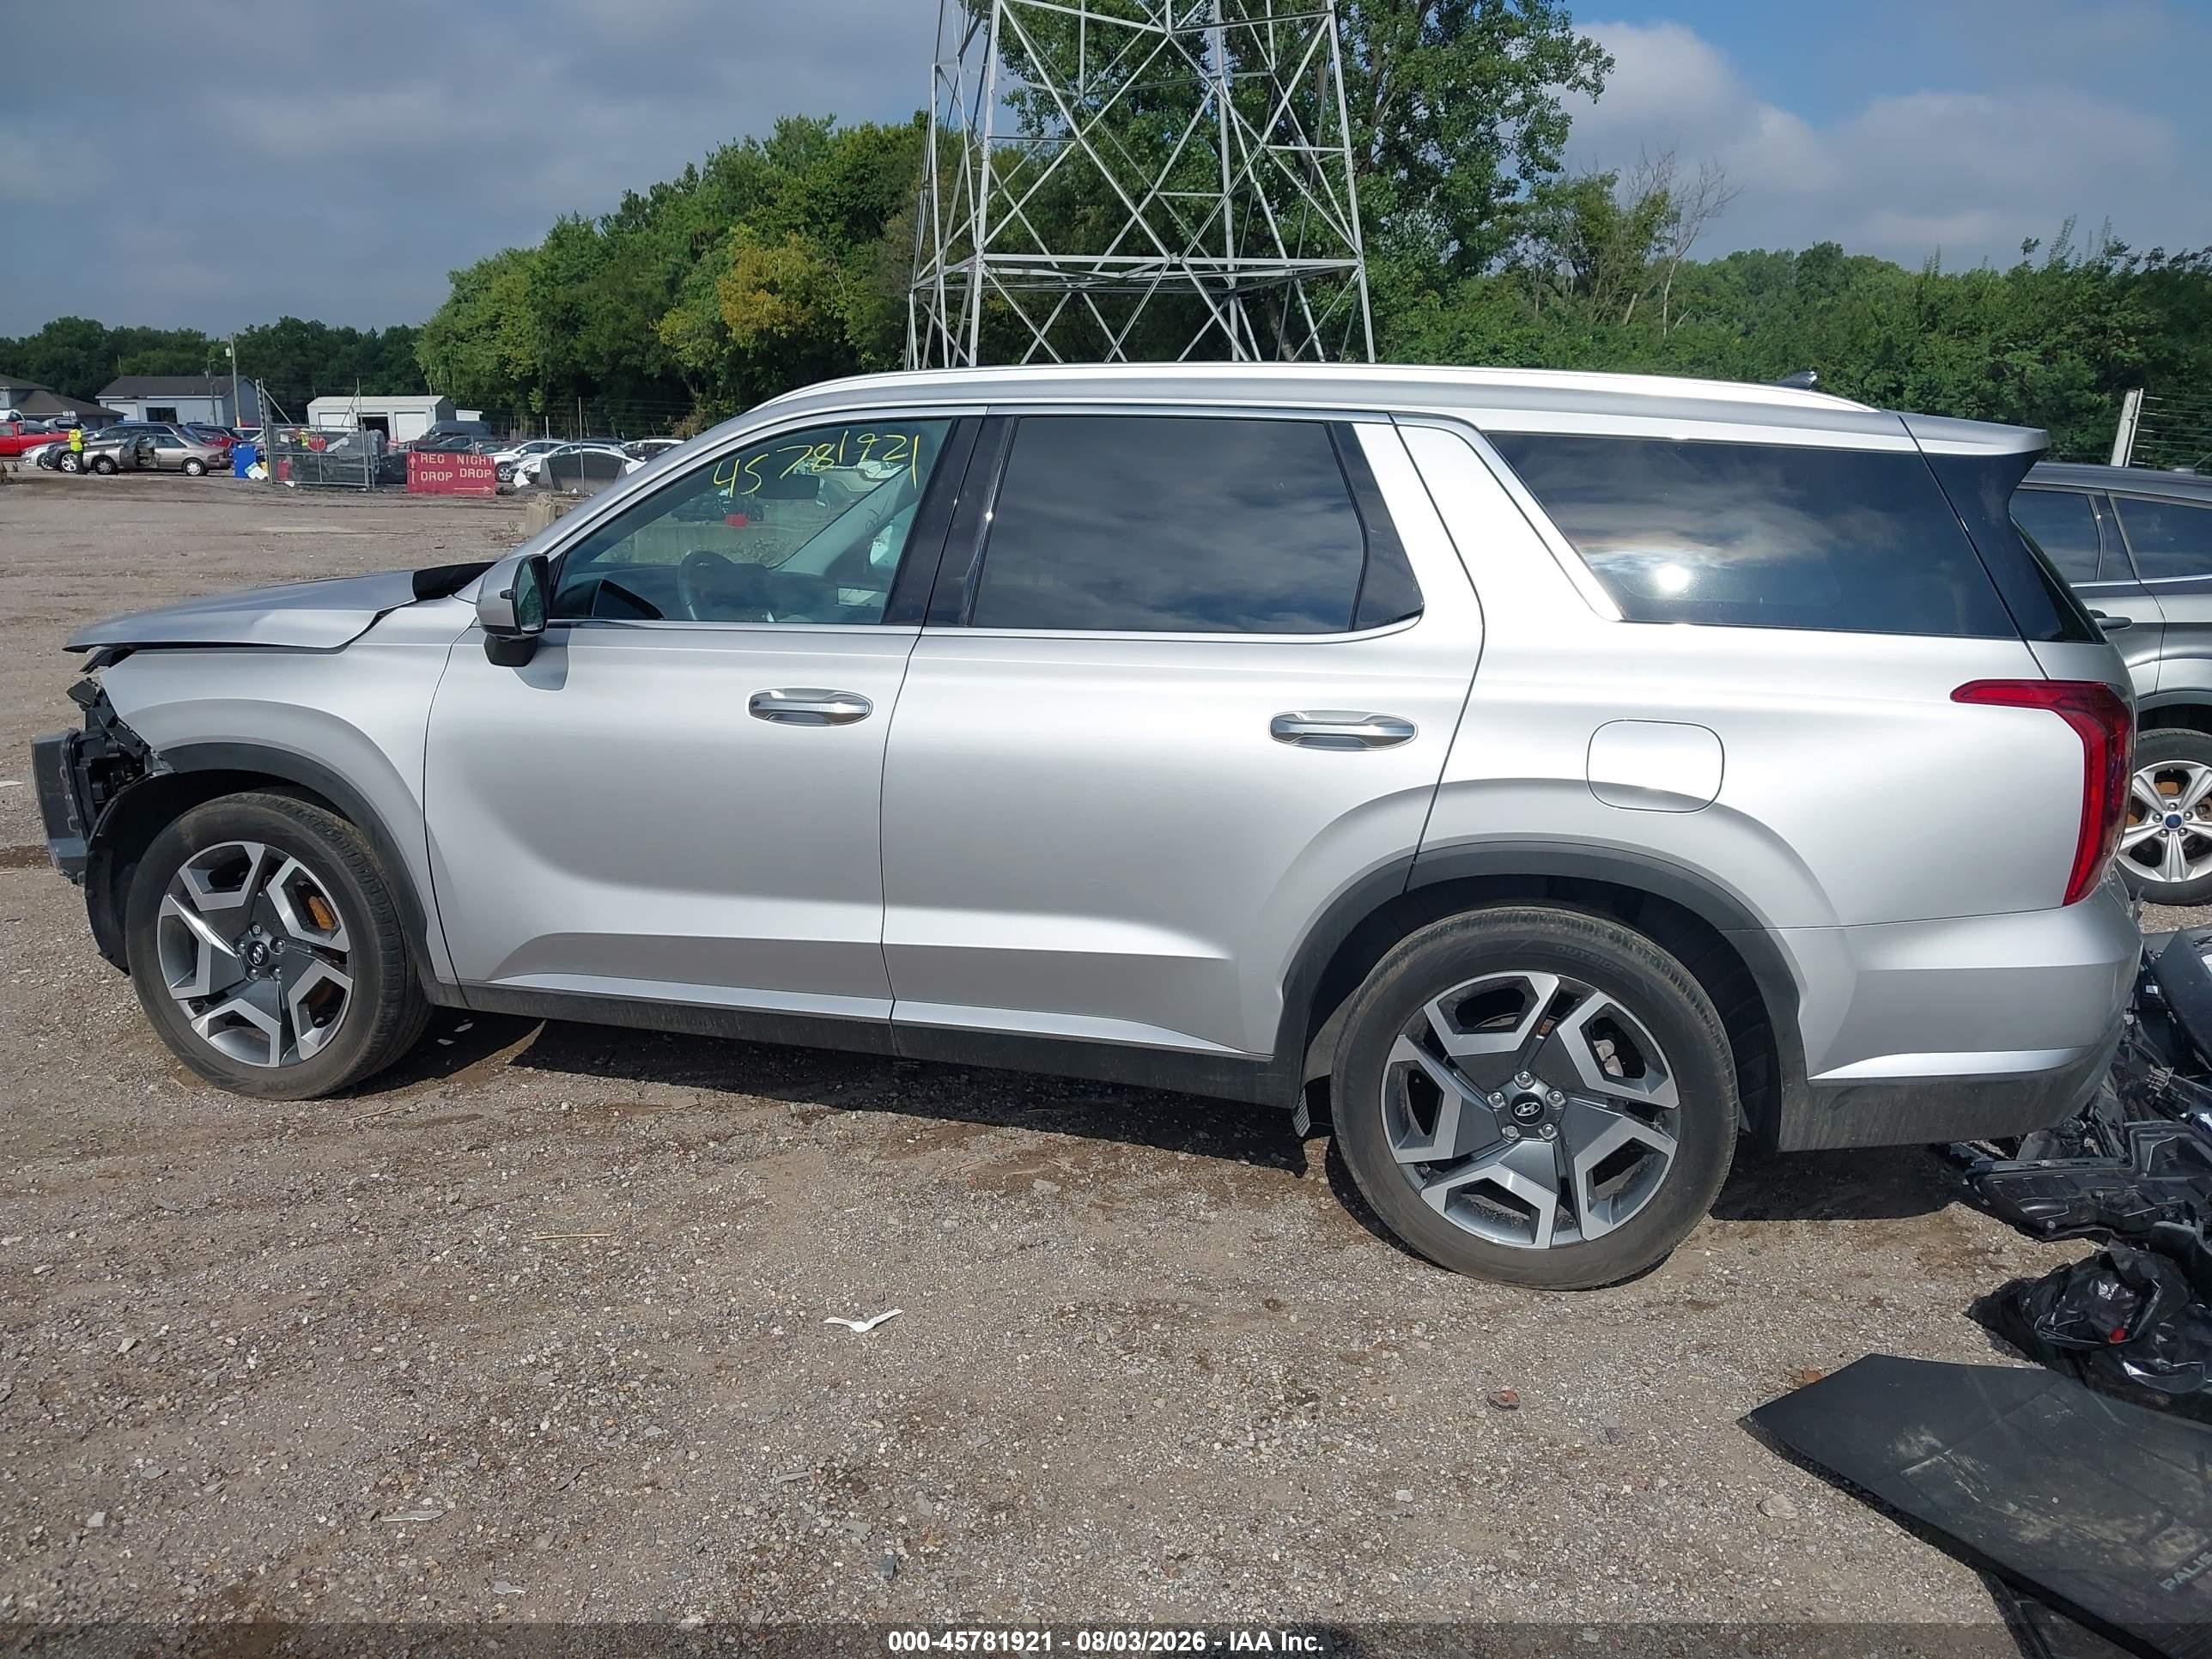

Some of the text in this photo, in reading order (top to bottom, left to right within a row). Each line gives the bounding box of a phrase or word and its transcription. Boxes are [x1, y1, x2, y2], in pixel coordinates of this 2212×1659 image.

[420, 453, 445, 464] REG
[456, 454, 495, 465] NIGHT
[420, 471, 453, 482] DROP
[459, 468, 492, 478] DROP
[1555, 945, 1624, 975] OUTSIDE
